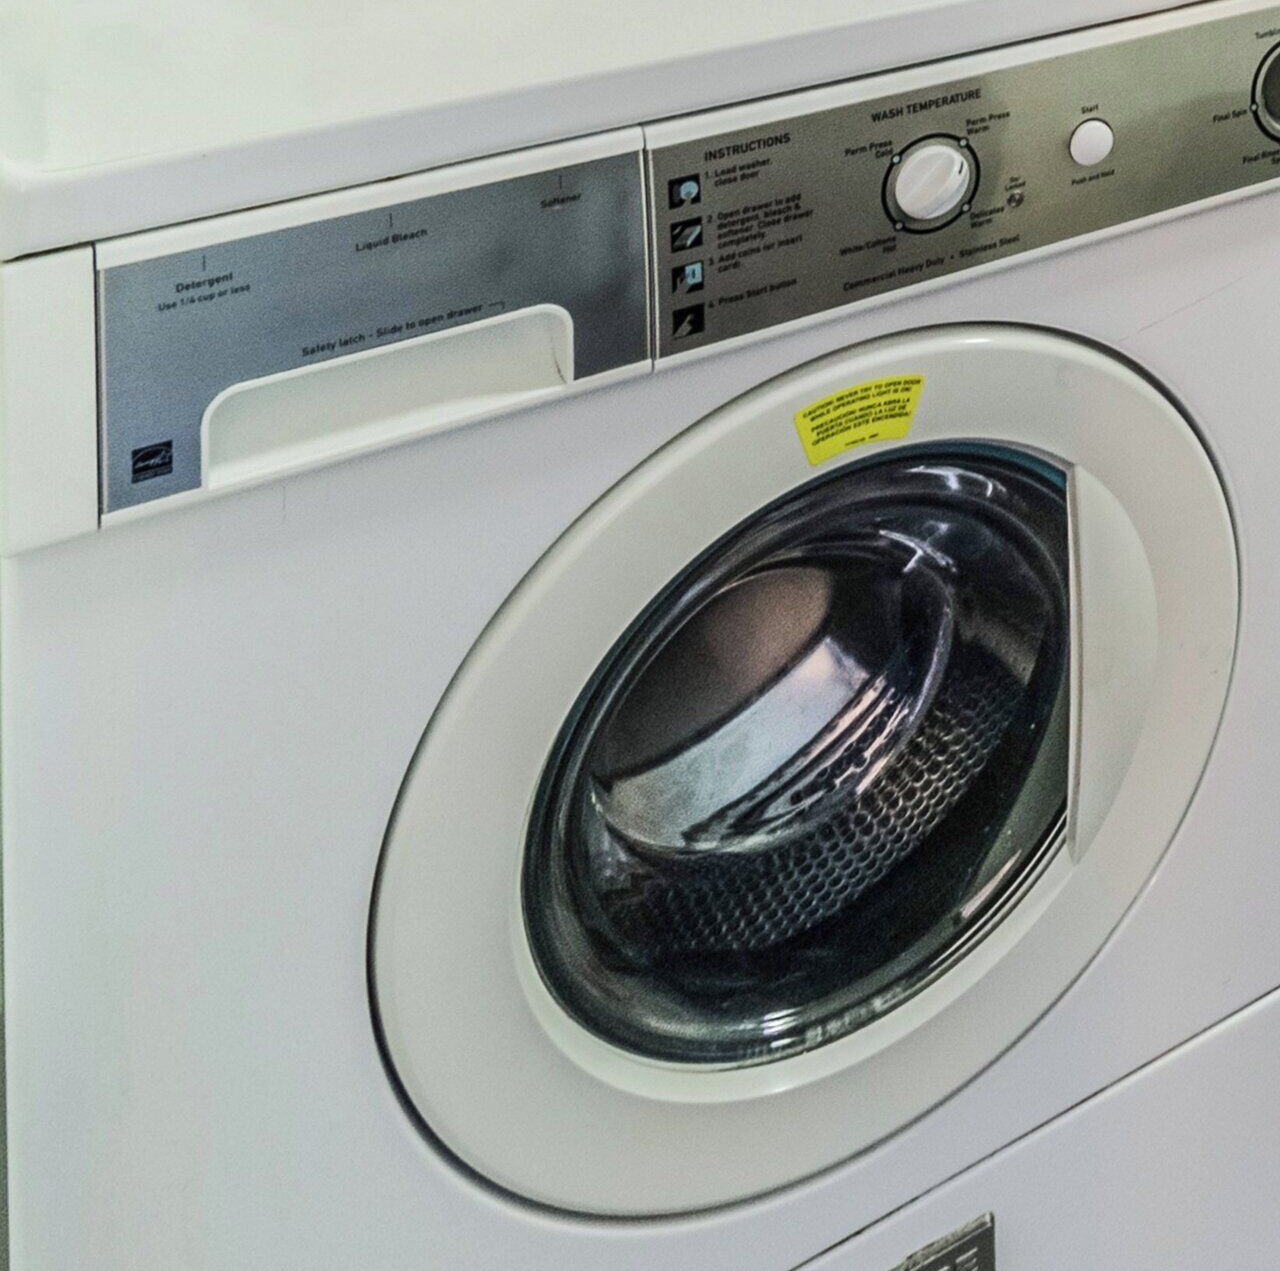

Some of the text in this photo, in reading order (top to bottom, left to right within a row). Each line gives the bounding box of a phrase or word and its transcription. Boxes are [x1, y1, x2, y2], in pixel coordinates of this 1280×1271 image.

[871, 88, 982, 122] WASH TEMPERATURE
[1082, 104, 1099, 115] Start
[966, 111, 1010, 128] Perm Press
[1212, 109, 1247, 123] Final Spin
[968, 126, 990, 136] Warm
[704, 132, 791, 162] INSTRUCTIONS
[844, 140, 892, 157] Perm Press
[875, 148, 894, 158] Cold
[714, 166, 736, 177] Load
[714, 170, 760, 187] close door
[540, 193, 582, 209] Softener
[718, 209, 740, 220] Open
[742, 200, 772, 214] drawer
[785, 193, 801, 204] add
[758, 218, 781, 229] Close
[784, 209, 814, 222] drawer
[764, 205, 792, 218] bleach
[356, 228, 428, 252] Liquid Bleach
[959, 234, 1020, 258] Stainless Steel
[718, 252, 736, 263] Add
[176, 272, 233, 293] Detergent
[843, 256, 945, 292] Commercial Heavy Duty
[158, 302, 177, 312] Use
[218, 289, 228, 298] or
[230, 284, 250, 294] less
[718, 294, 744, 305] Press
[746, 286, 768, 298] Start
[302, 341, 336, 357] Safety
[338, 334, 366, 348] latch
[376, 324, 403, 338] Slide
[406, 320, 416, 330] to
[418, 315, 444, 328] open
[446, 304, 484, 321] drawer
